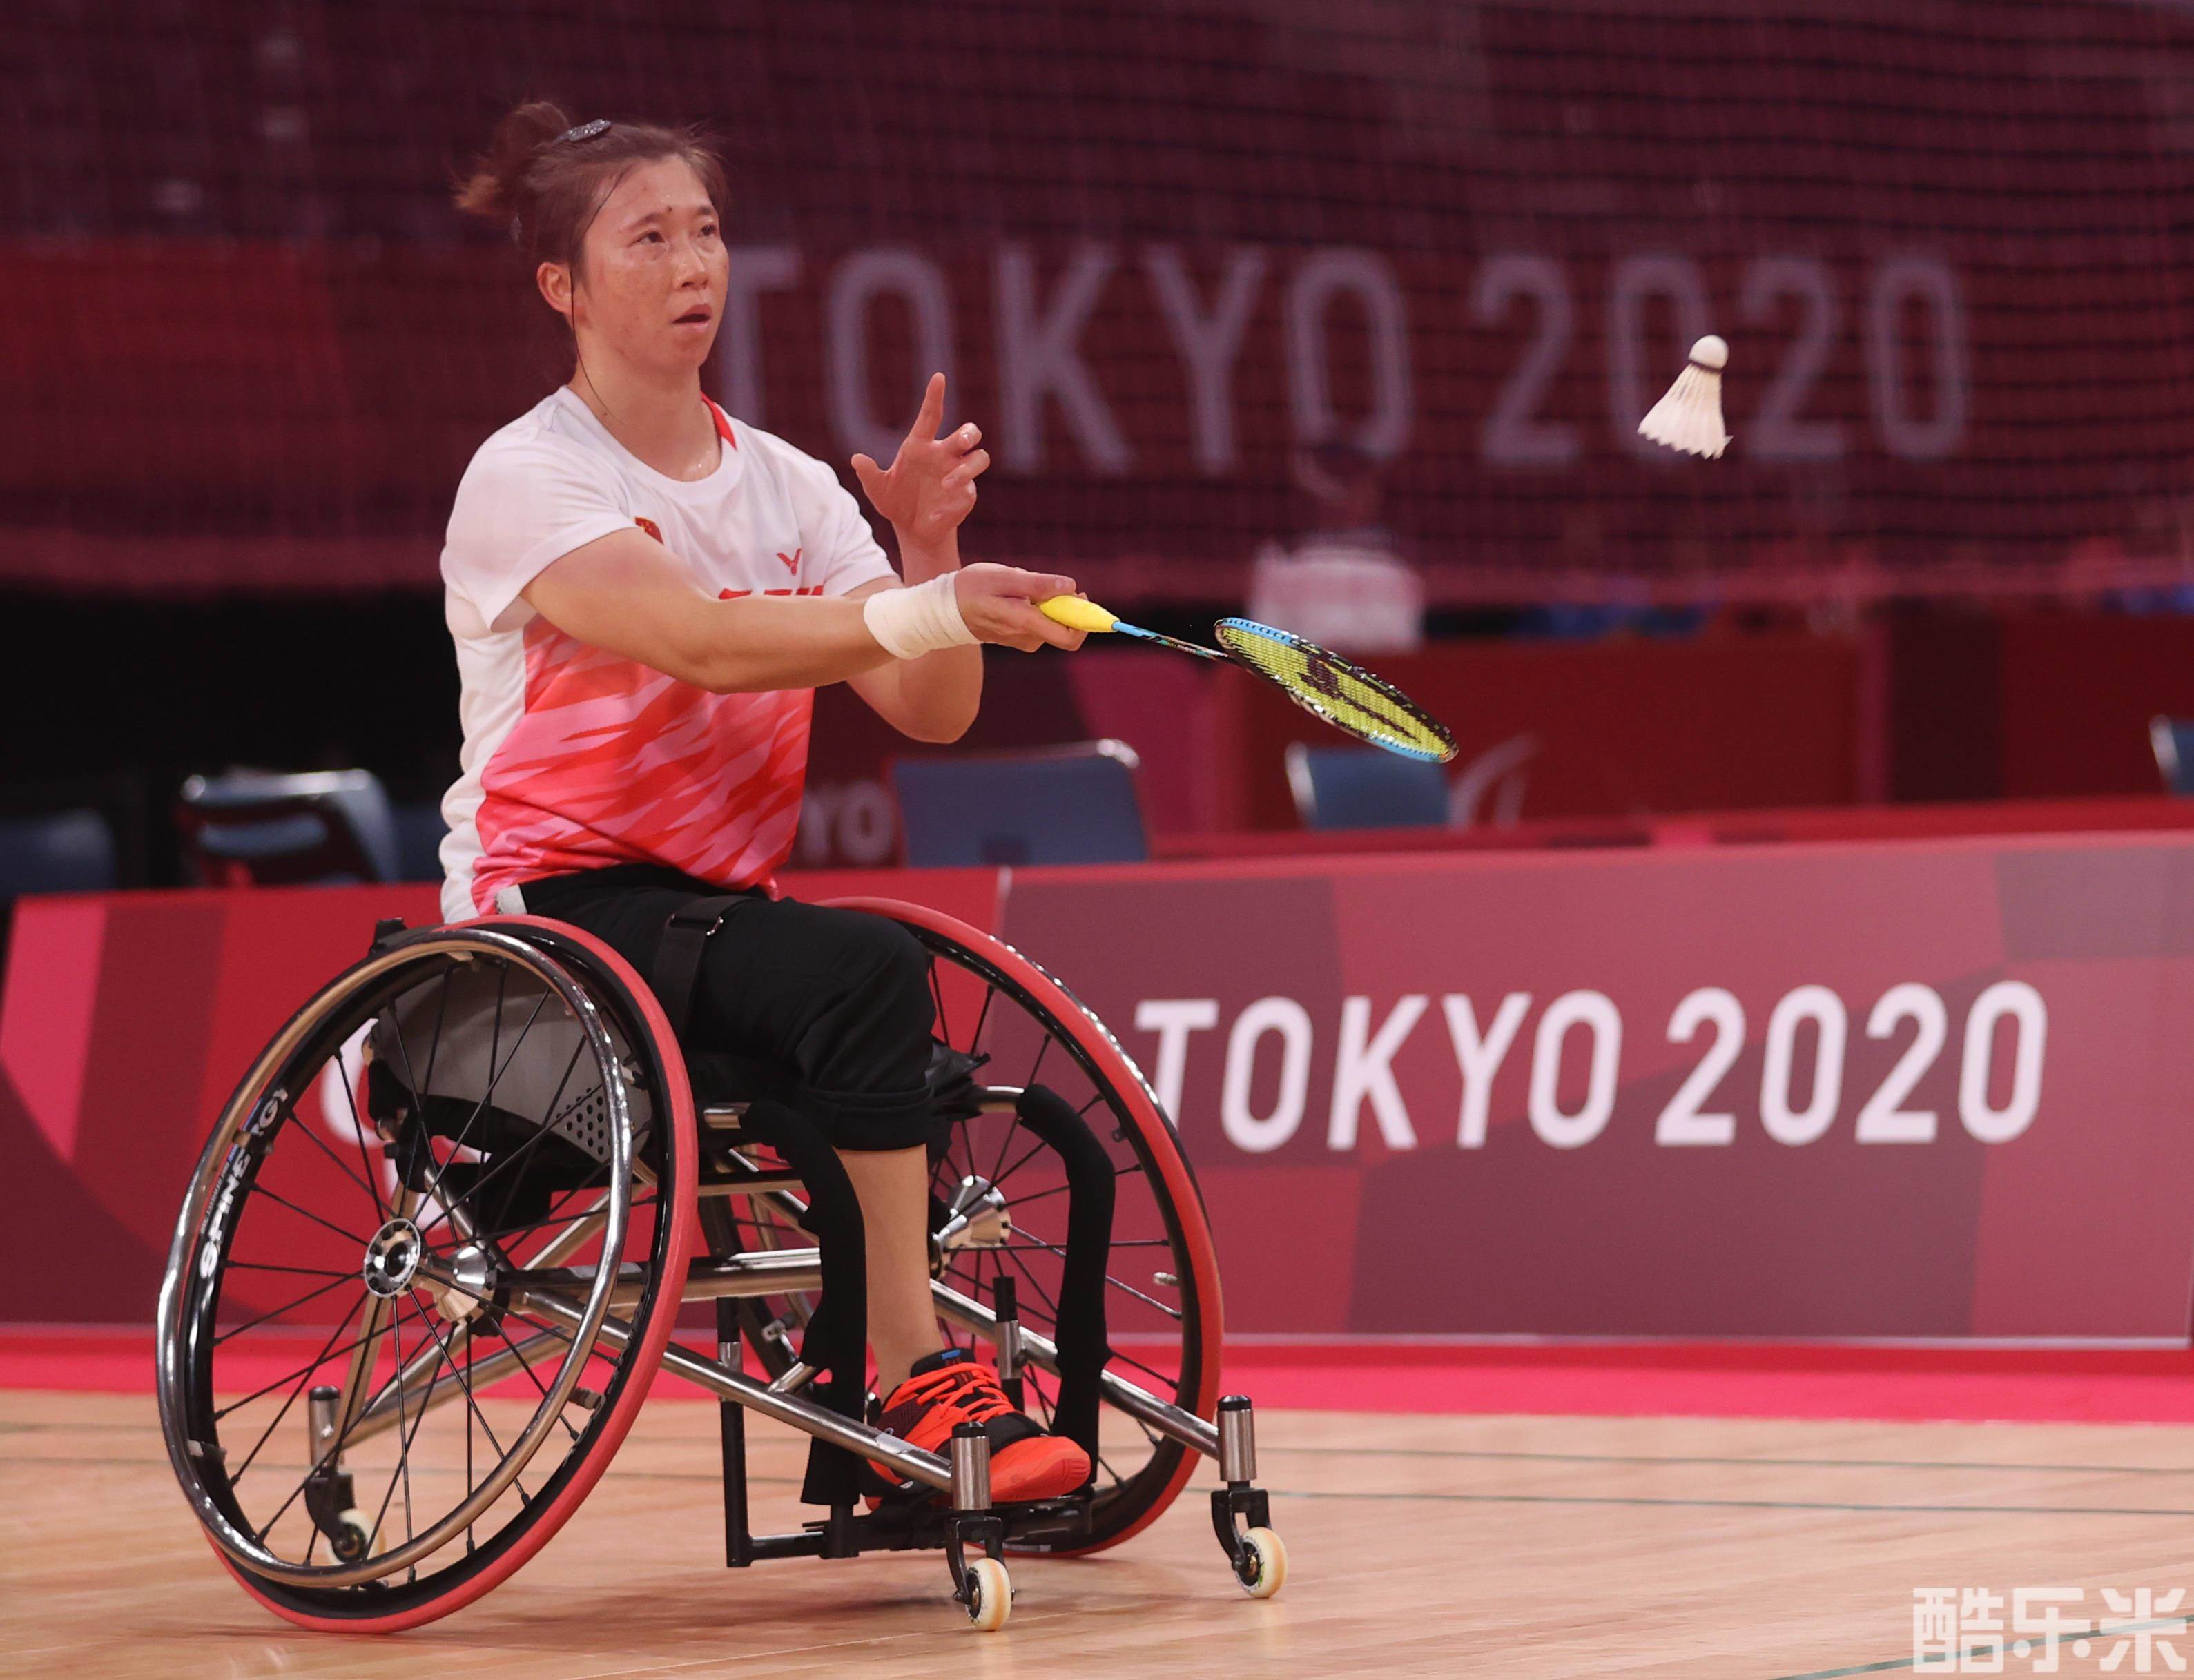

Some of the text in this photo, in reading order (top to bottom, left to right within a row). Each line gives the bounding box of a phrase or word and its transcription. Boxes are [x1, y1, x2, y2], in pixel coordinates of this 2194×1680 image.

[719, 242, 1974, 473] TOKYO 2020
[1134, 980, 2048, 1153] TOKYO 2020
